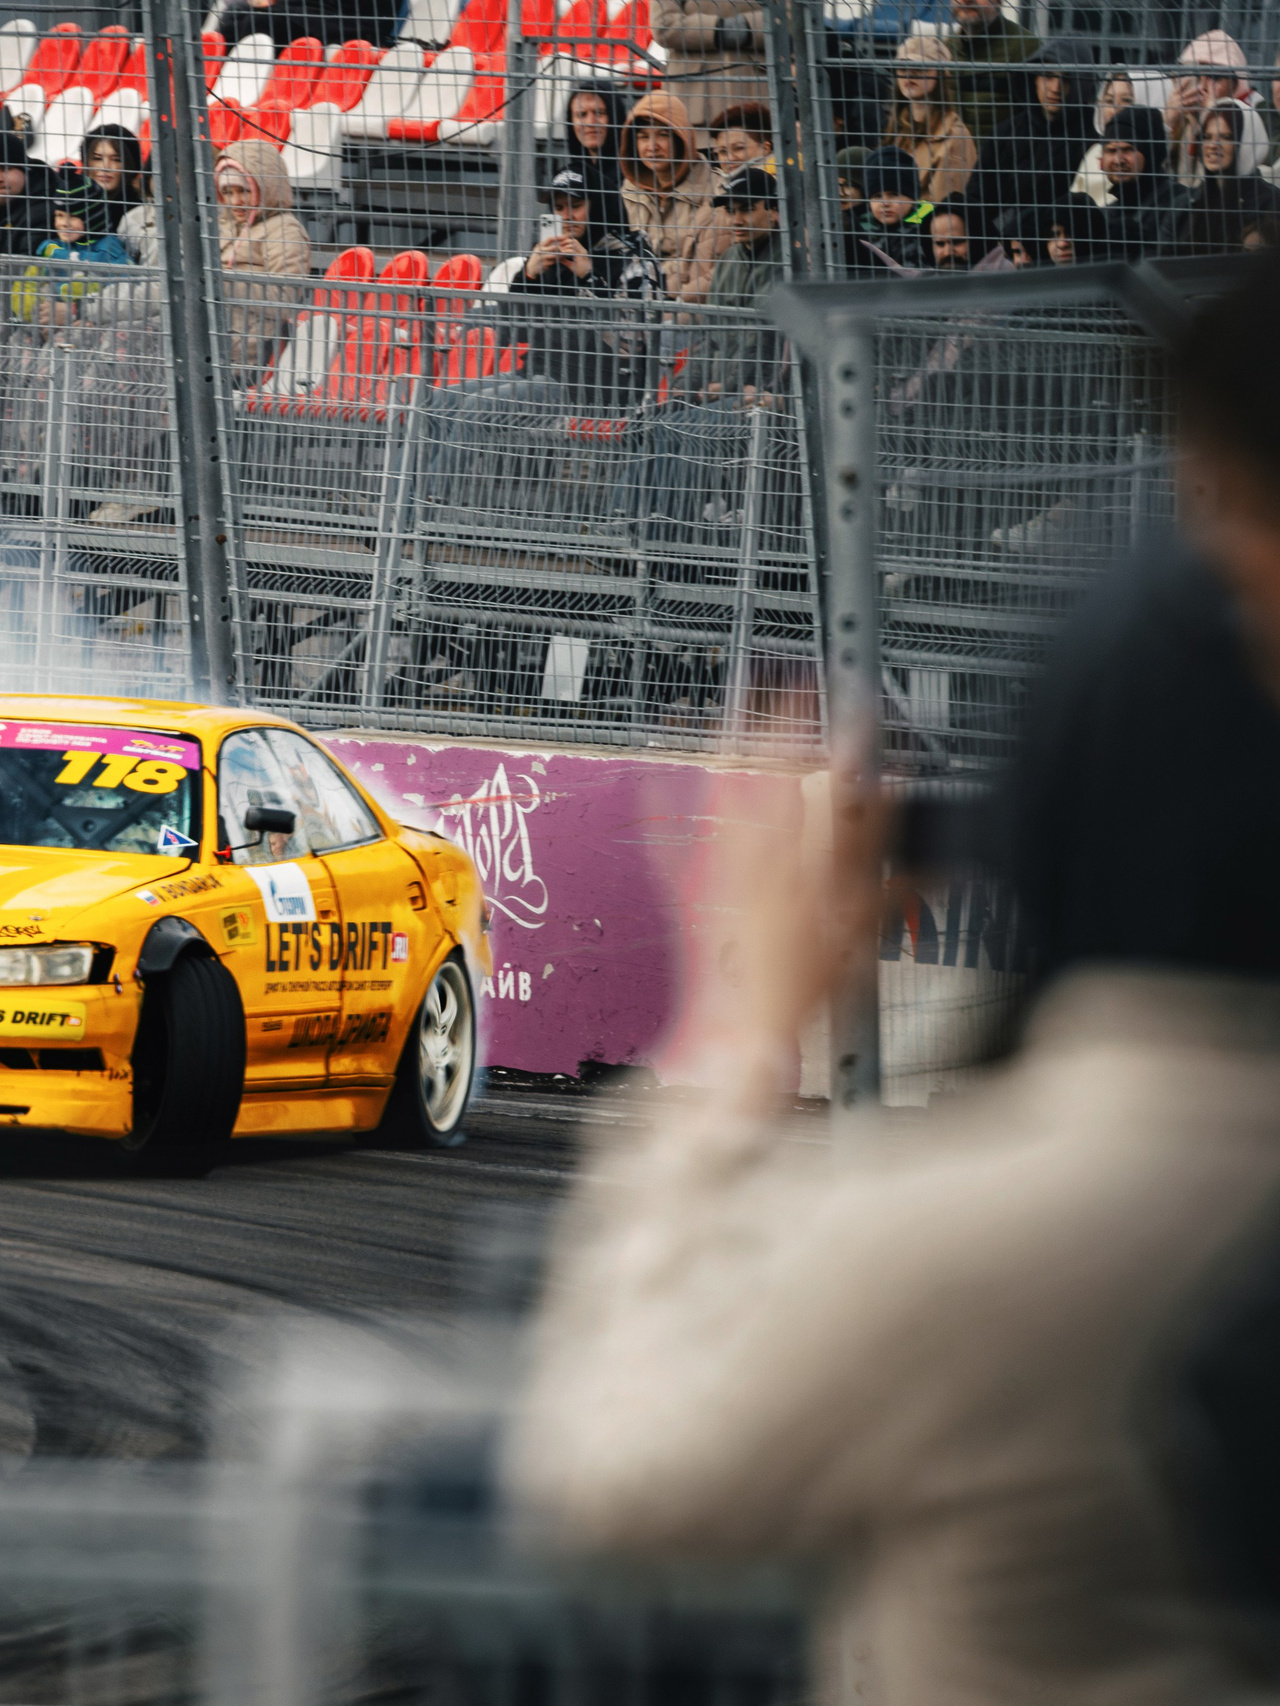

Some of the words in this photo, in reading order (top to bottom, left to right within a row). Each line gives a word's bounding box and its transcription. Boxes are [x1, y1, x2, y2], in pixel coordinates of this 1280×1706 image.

[54, 750, 188, 794] 118
[264, 921, 322, 973] LET'S
[329, 921, 392, 971] DRIFT
[479, 962, 532, 1001] АЙВ
[11, 1011, 70, 1027] DRIFT
